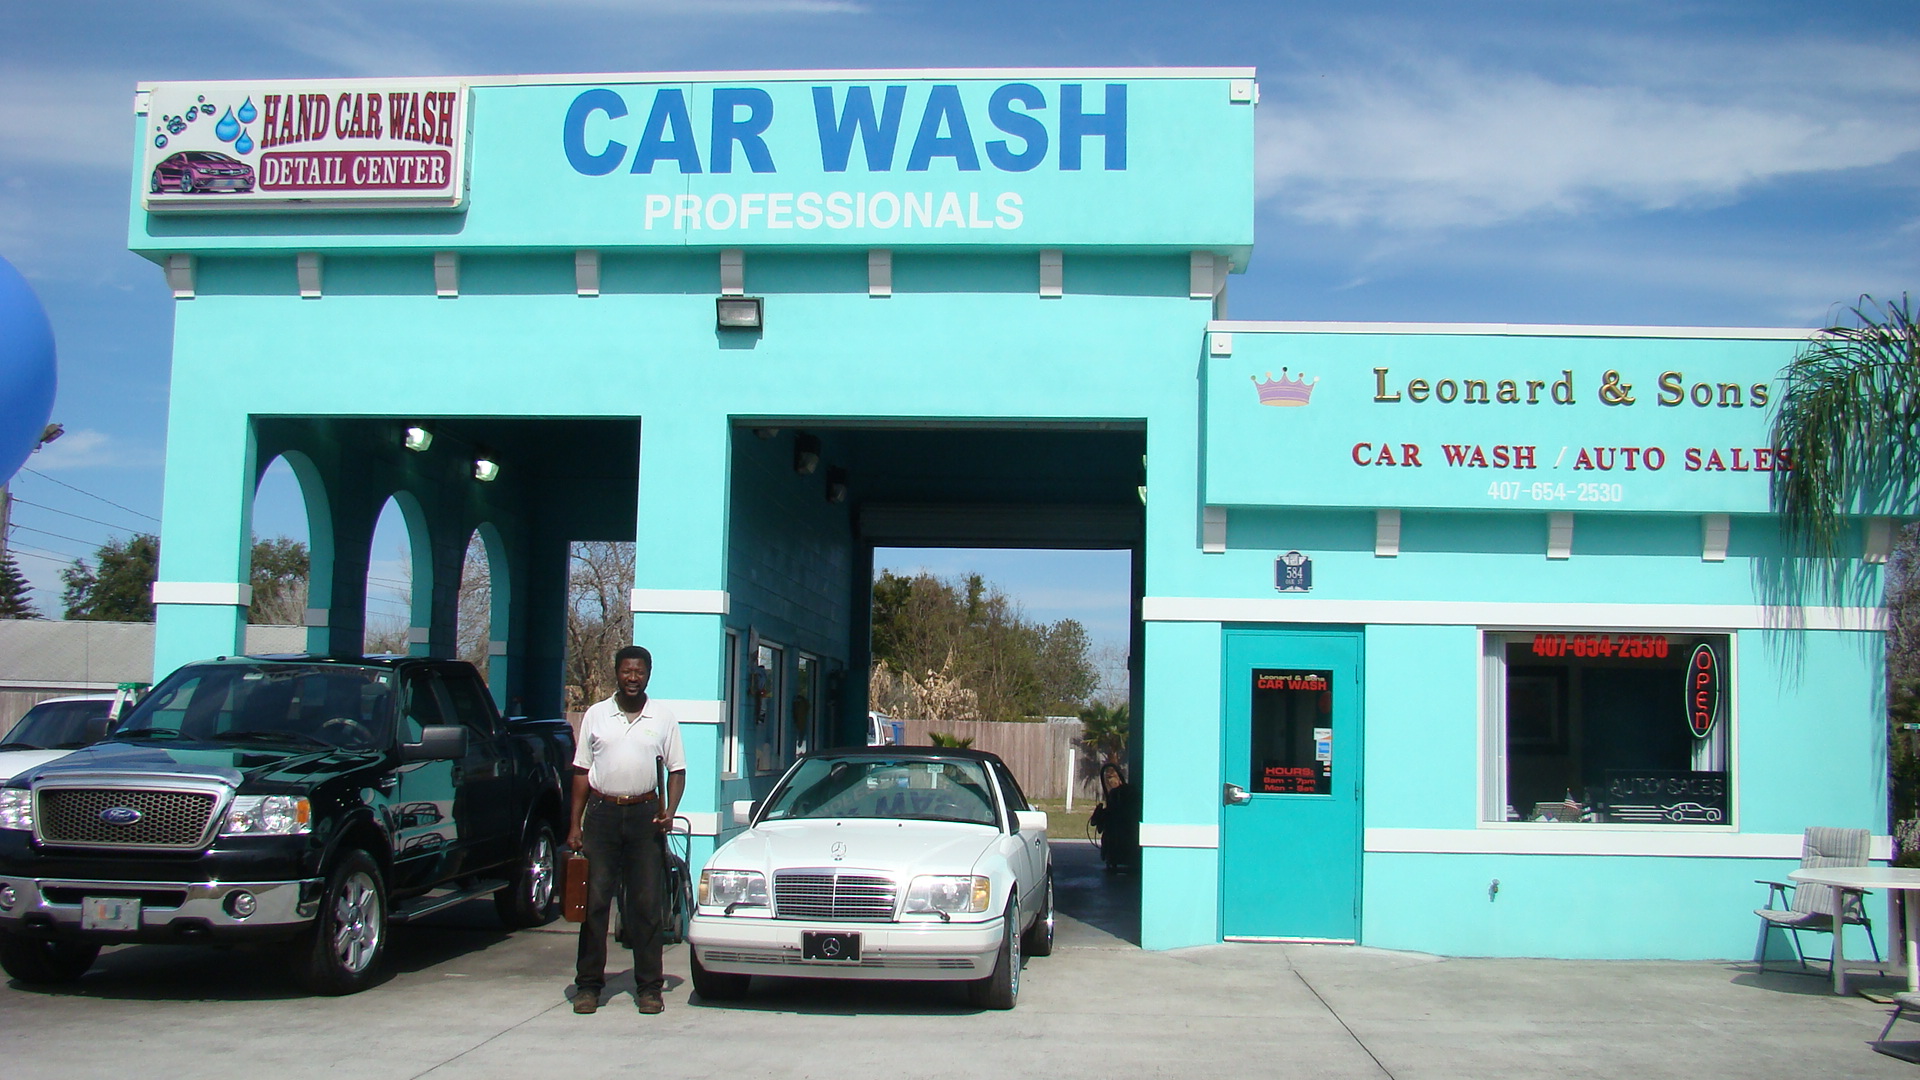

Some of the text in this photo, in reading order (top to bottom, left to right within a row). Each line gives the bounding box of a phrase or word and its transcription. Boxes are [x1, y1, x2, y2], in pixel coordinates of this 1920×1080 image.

[261, 91, 456, 149] HAND CAR WASH
[563, 83, 1128, 176] CAR WASH
[263, 156, 446, 185] DETAIL CENTER
[644, 191, 1024, 230] PROFESSIONALS
[1373, 367, 1769, 408] Leonard & Sons
[1352, 442, 1422, 467] CAR
[1441, 444, 1537, 469] WASH
[1573, 447, 1665, 471] AUTO
[1685, 447, 1795, 472] SALES
[1487, 481, 1623, 502] 407-654-2530
[1286, 566, 1303, 579] 584
[1532, 634, 1668, 658] 407-654-2530
[1257, 679, 1328, 691] CAR WASH
[1696, 651, 1711, 729] OPEN
[1265, 767, 1315, 776] HOURS:
